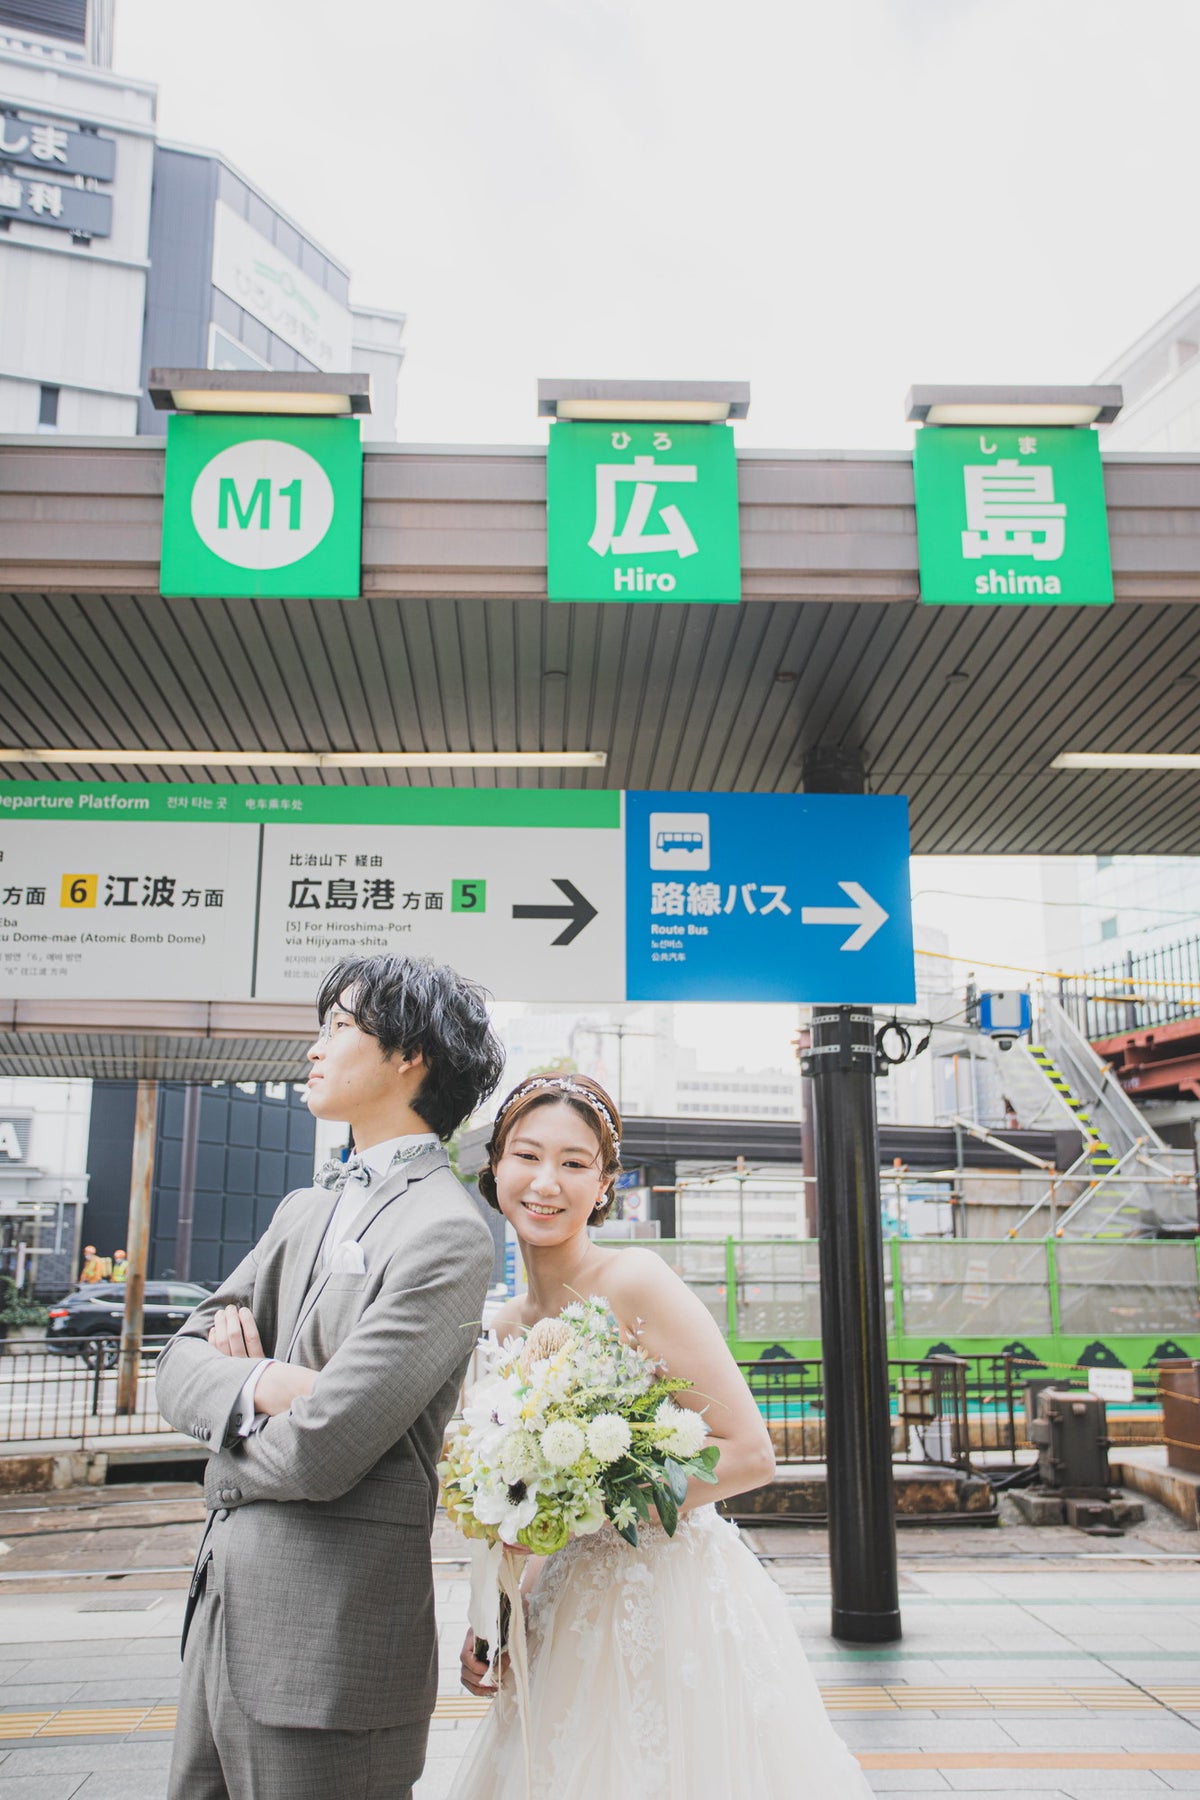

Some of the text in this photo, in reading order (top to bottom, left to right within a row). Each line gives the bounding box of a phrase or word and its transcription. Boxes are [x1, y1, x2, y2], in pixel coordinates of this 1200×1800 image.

[218, 478, 302, 530] M1
[587, 455, 699, 559] 広
[961, 459, 1067, 561] 島
[613, 567, 677, 592] Hiro
[975, 570, 1062, 595] shima
[0, 794, 150, 811] eparture Platform
[289, 853, 383, 867] 比治山下 経由
[2, 887, 46, 906] 方面
[70, 879, 87, 903] 6
[103, 875, 176, 907] 江波
[288, 878, 477, 910] 広島港 方面 5
[650, 882, 792, 916] 路線バス
[13, 932, 77, 943] Dome-mae
[81, 933, 127, 944] (Atomic
[130, 933, 164, 944] Bomb
[167, 933, 206, 945] Dome)
[286, 921, 412, 933] [5] For Hiroshima-Port
[651, 924, 708, 936] Route Bus
[286, 936, 388, 949] via Hijiyama-shita
